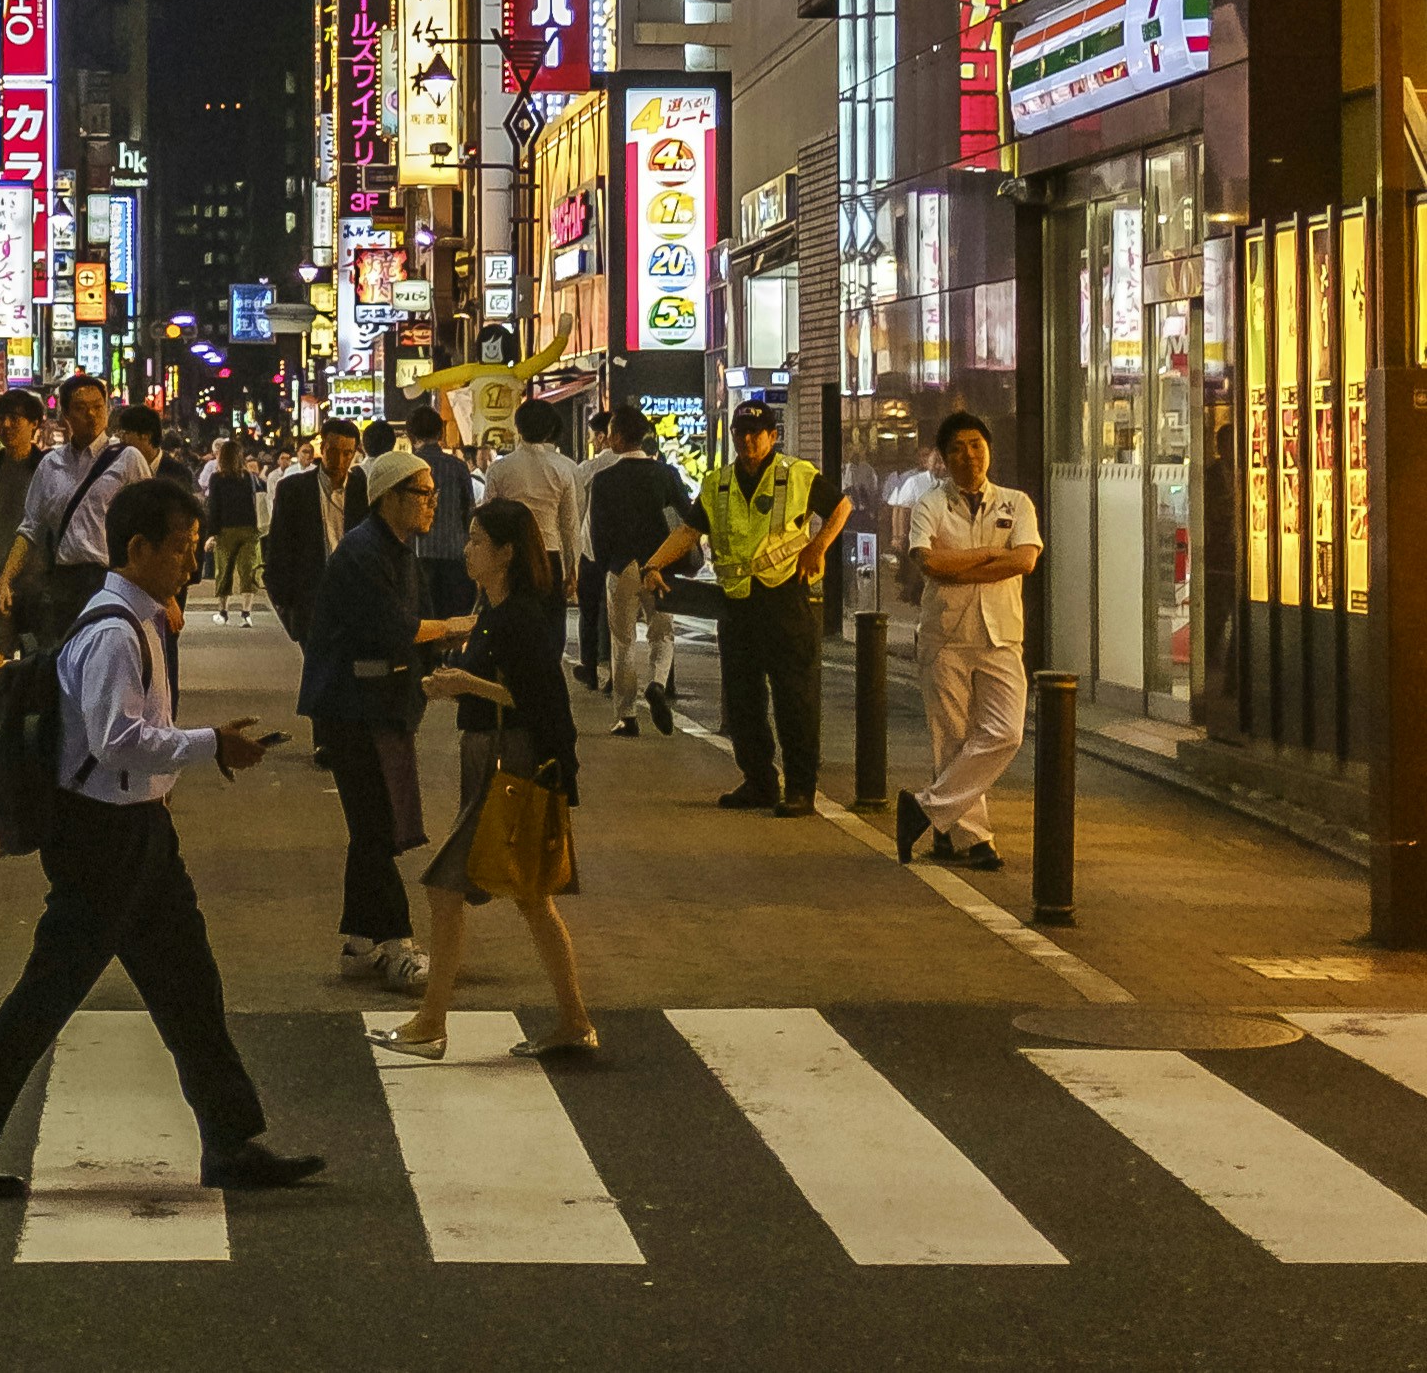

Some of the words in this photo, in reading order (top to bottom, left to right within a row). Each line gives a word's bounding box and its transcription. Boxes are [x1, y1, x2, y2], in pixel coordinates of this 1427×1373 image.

[631, 96, 665, 134] 4
[666, 109, 711, 129] レート
[118, 141, 148, 174] hk
[350, 193, 379, 212] 3F
